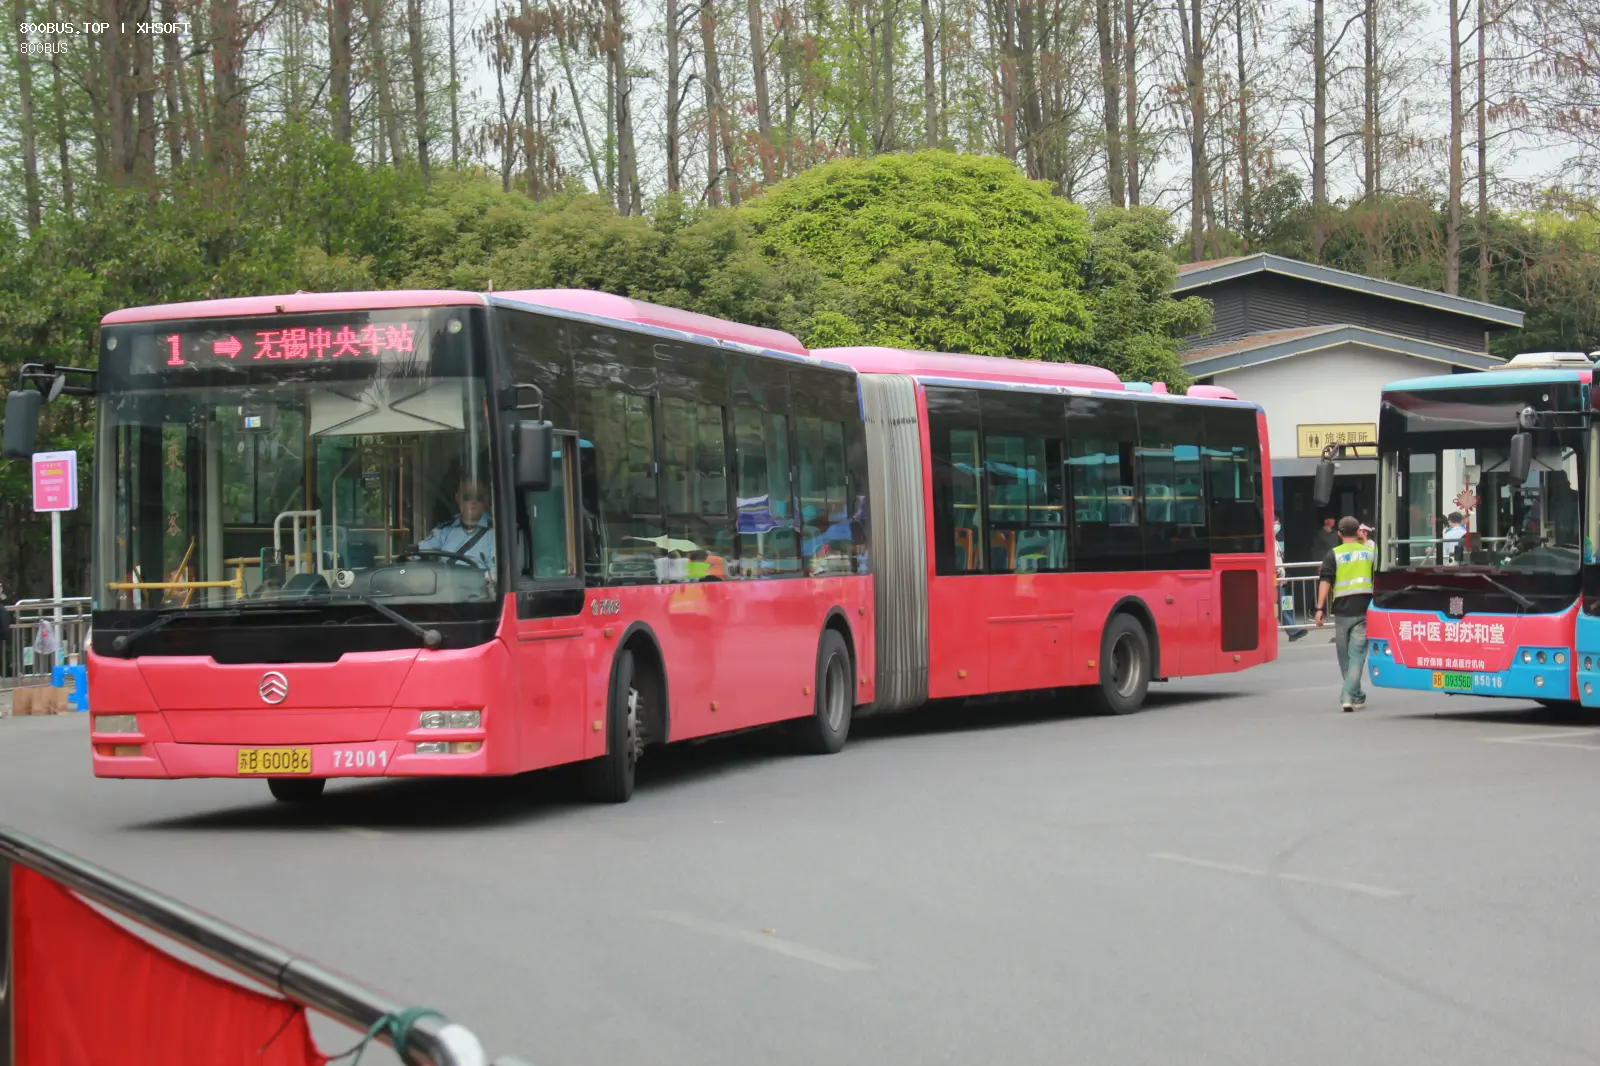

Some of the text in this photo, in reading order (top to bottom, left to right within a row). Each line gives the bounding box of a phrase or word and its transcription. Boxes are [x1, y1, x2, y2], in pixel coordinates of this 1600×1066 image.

[167, 323, 414, 365] 1 无锡中央车站
[1325, 431, 1368, 445] 旅游厕所
[1399, 621, 1504, 644] 看中医 到苏和堂
[1417, 657, 1485, 670] 医疗保障 定点医疗机构
[333, 750, 388, 768] 72001
